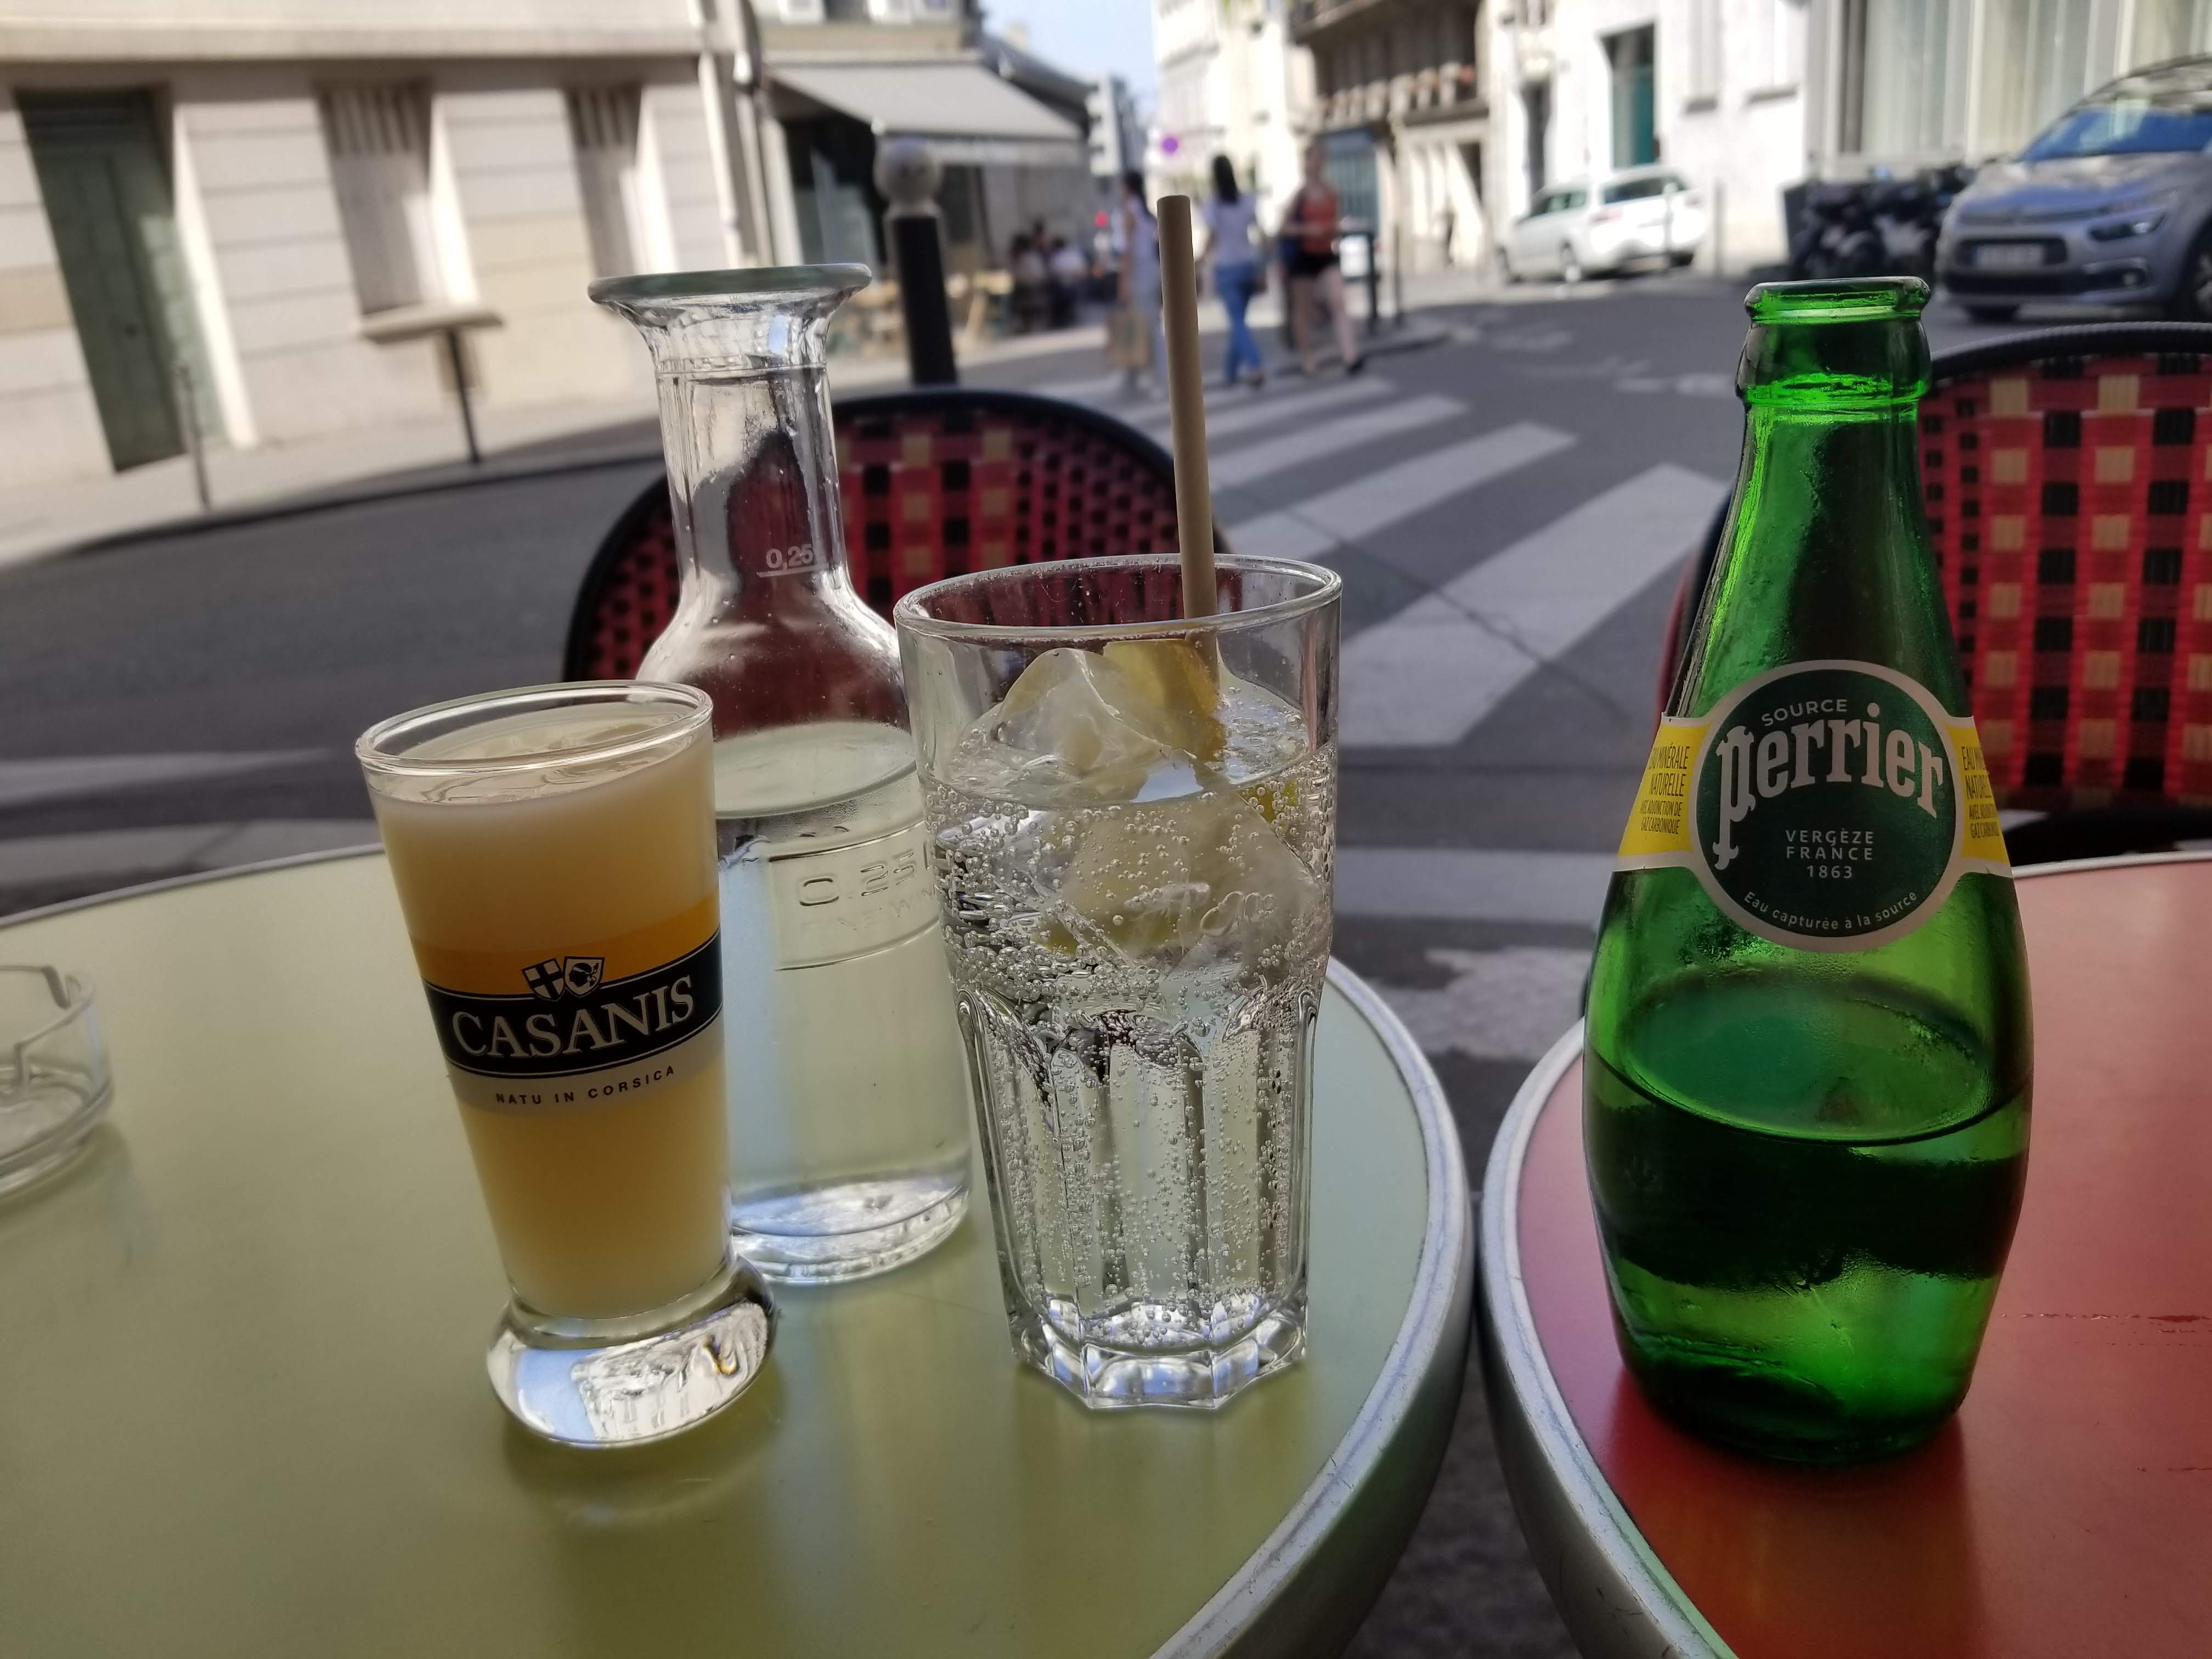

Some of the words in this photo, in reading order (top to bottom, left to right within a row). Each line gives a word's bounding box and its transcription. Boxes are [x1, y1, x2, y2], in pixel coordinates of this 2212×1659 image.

[766, 543, 814, 570] 0,25
[1762, 698, 1847, 727] SOURCE
[1656, 742, 1690, 769] MINÉRALE
[1649, 772, 1686, 797] NATURELLE
[1713, 702, 1944, 871] perrier
[1674, 802, 1683, 817] DE
[1785, 828, 1874, 846] VERGÈZE
[1786, 847, 1873, 860] FRANCE
[1806, 865, 1852, 878] 1863
[1744, 891, 1768, 912] Eau
[1772, 908, 1838, 929] capturée
[1844, 916, 1852, 929] à
[1857, 915, 1871, 927] la
[1875, 891, 1917, 922] source
[451, 974, 695, 1059] CASANIS
[495, 1092, 541, 1105] NATU
[555, 1091, 575, 1103] IN
[588, 1065, 675, 1099] CORSICA
